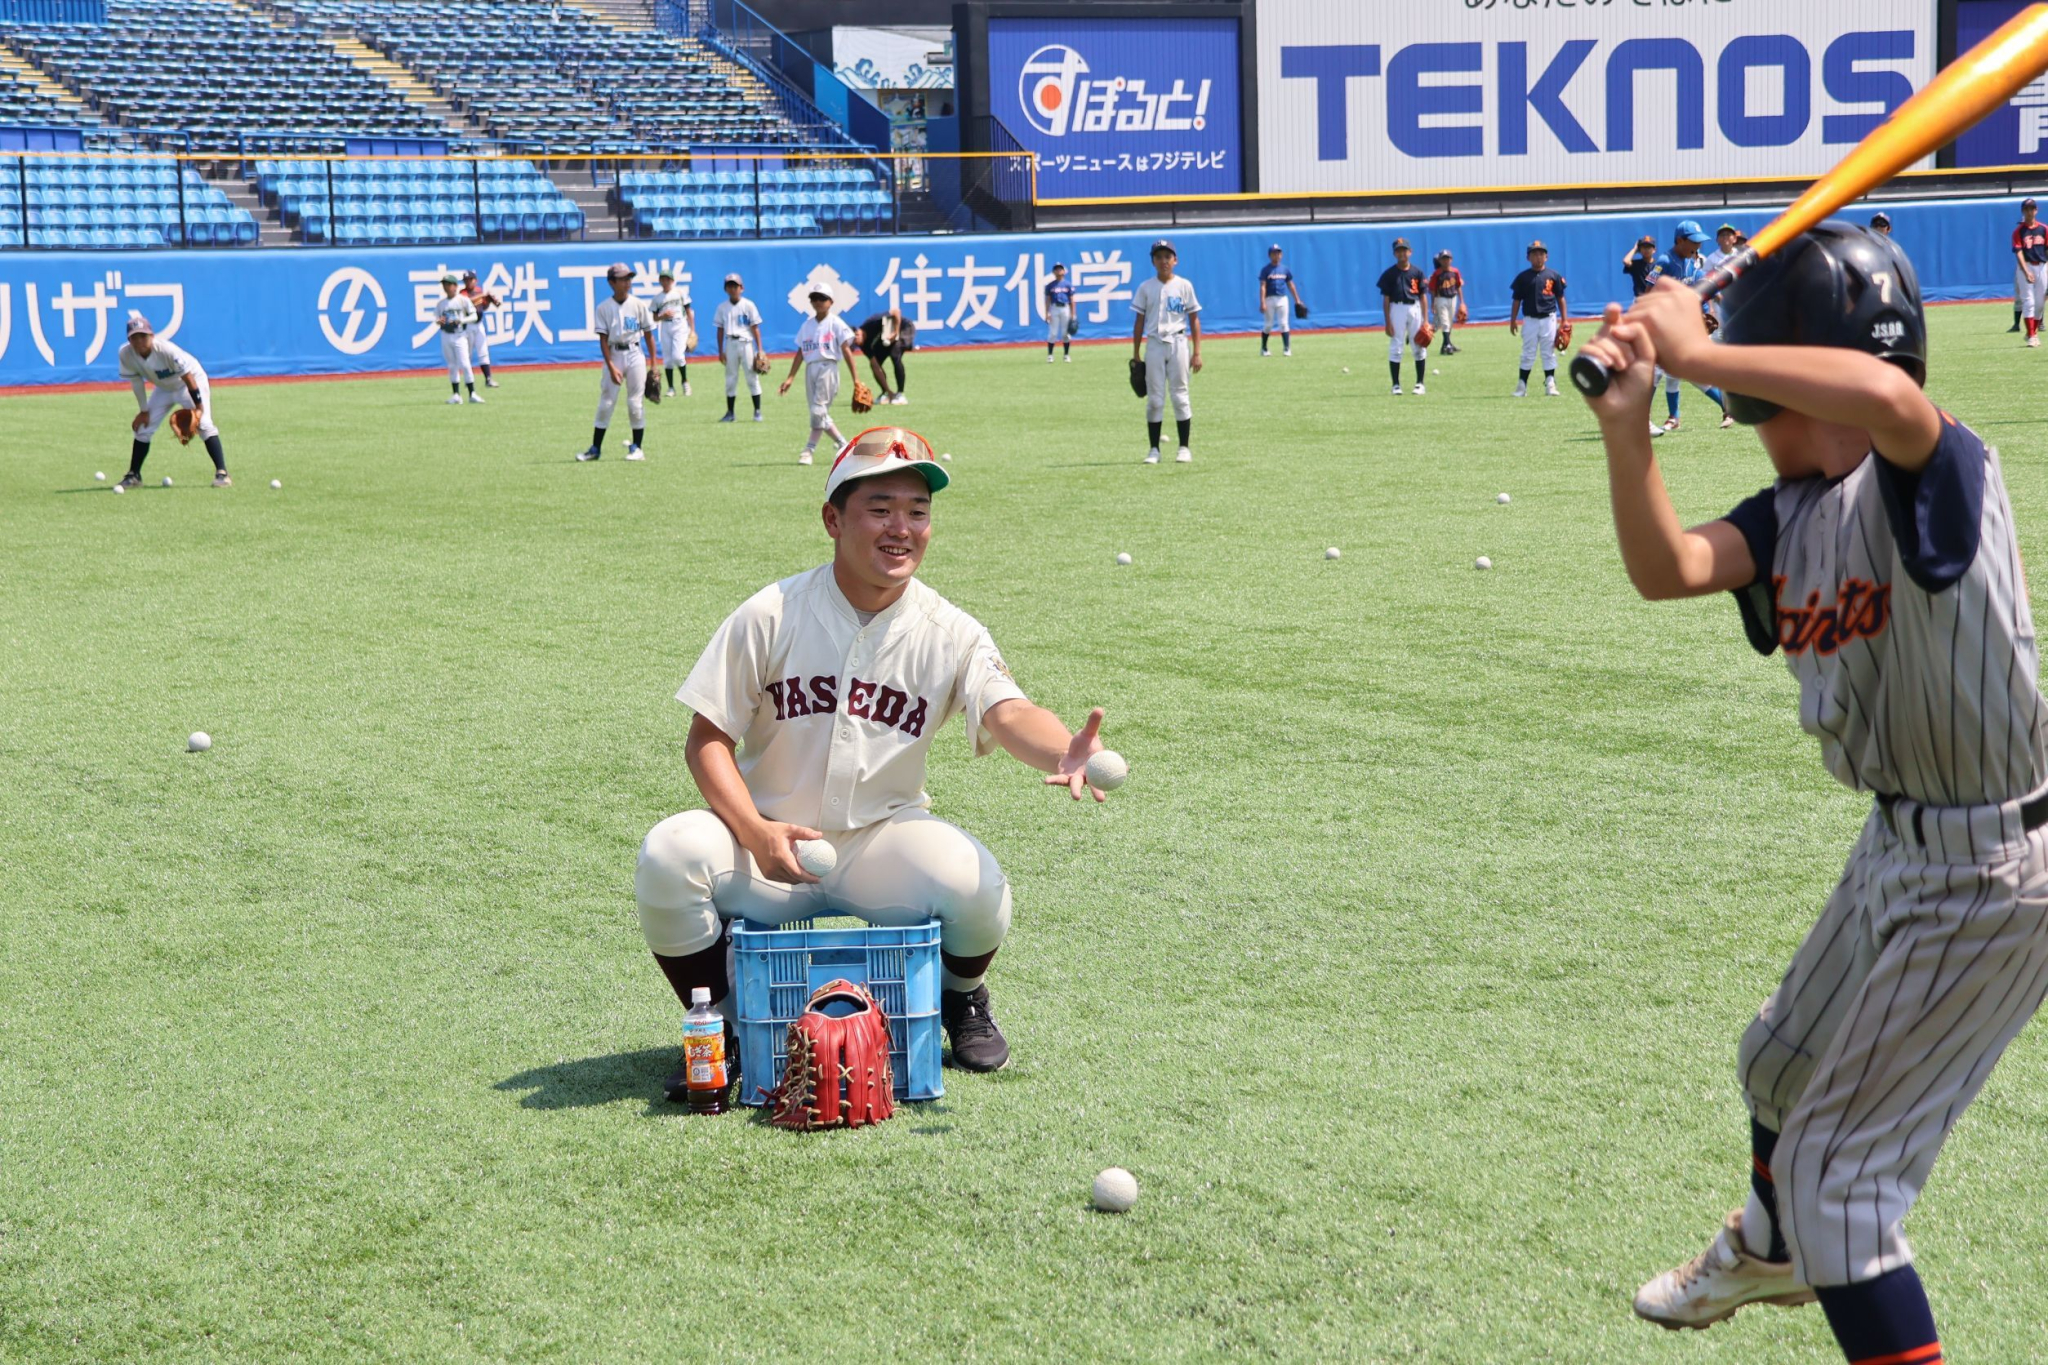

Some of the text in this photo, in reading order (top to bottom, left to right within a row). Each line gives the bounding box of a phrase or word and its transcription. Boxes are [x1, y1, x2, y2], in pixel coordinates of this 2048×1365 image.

[0, 271, 184, 367] ハザマ
[874, 250, 1132, 331] 住友化学
[1871, 272, 1892, 304] 7
[1773, 575, 1891, 657] aints
[765, 675, 928, 738] WASEDA
